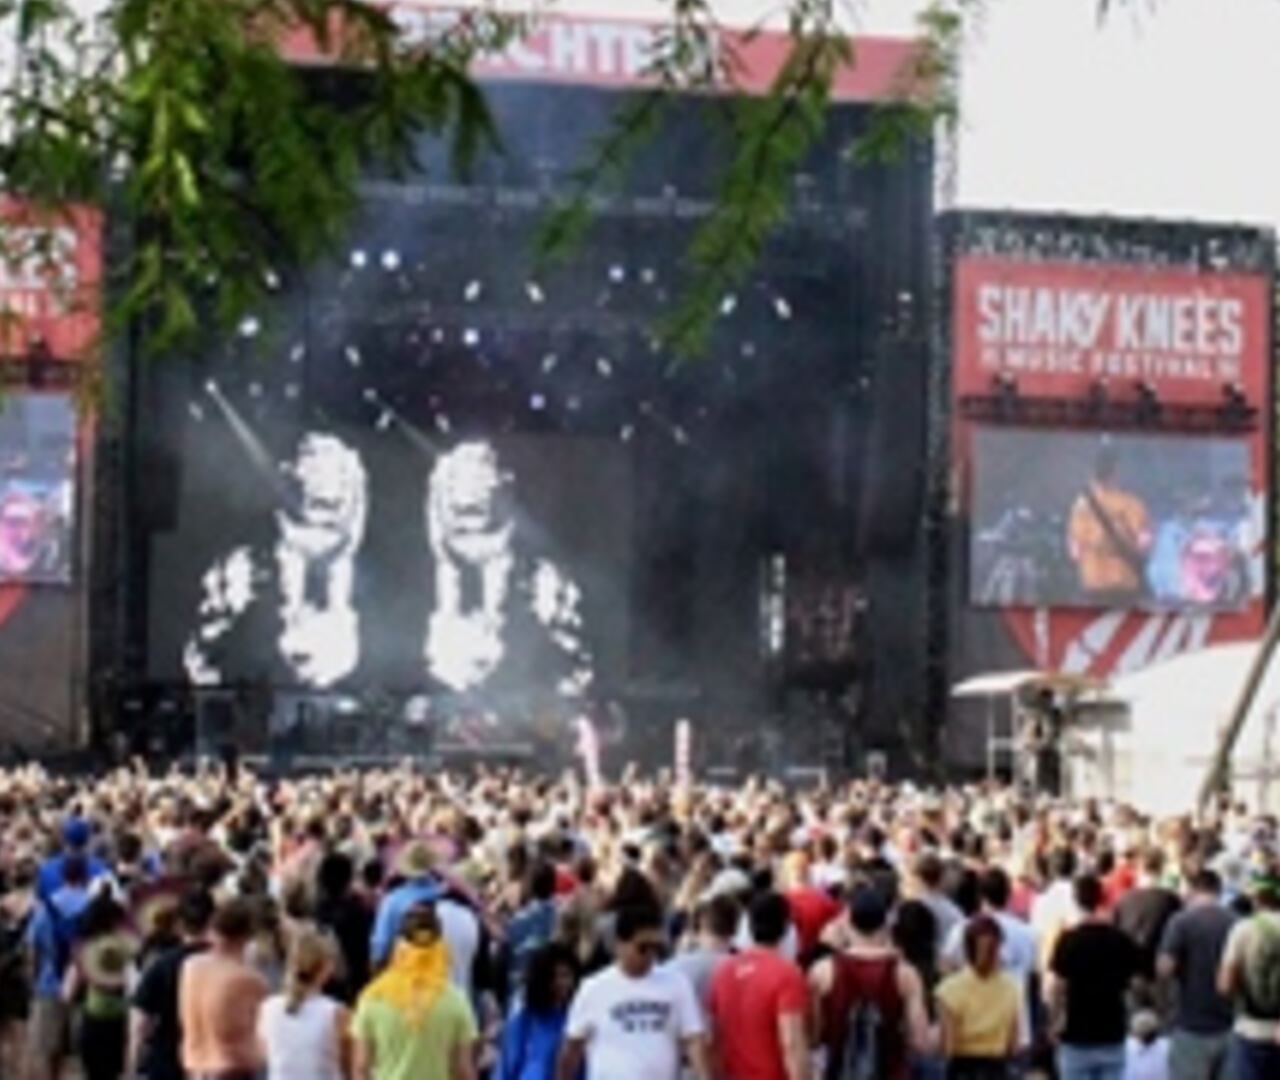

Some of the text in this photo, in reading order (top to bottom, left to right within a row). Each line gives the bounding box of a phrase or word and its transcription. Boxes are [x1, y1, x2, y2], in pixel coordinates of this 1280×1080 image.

[390, 7, 722, 85] PEACHTR
[977, 284, 1243, 356] SHAKY KNEES
[1005, 348, 1213, 379] MUSIC FESTIVAL
